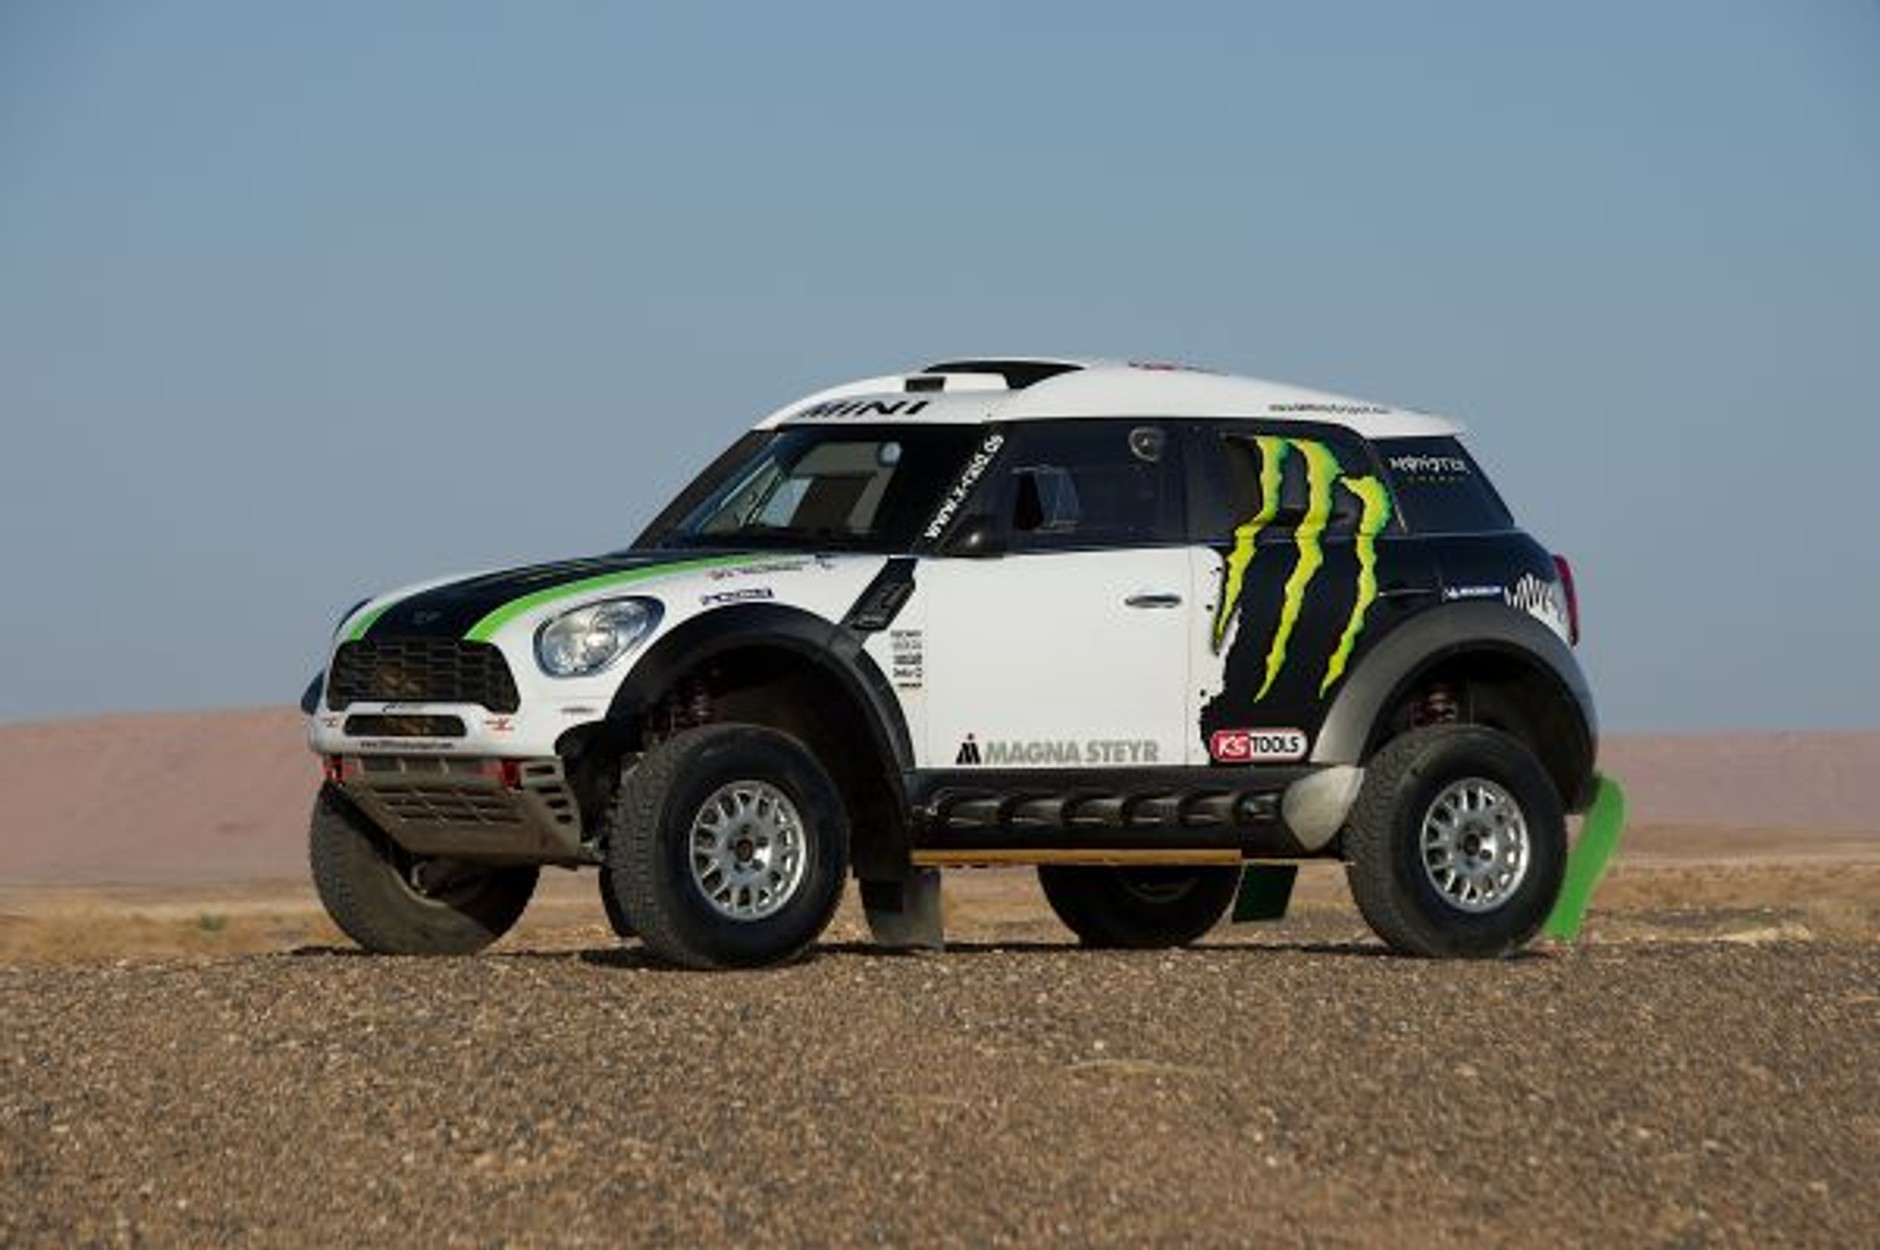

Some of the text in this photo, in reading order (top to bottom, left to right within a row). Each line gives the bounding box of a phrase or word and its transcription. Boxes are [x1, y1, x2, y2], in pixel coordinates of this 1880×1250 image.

[800, 401, 929, 417] MINI
[984, 739, 1159, 764] MAGNA STEYR
[1250, 735, 1300, 753] TOOLS
